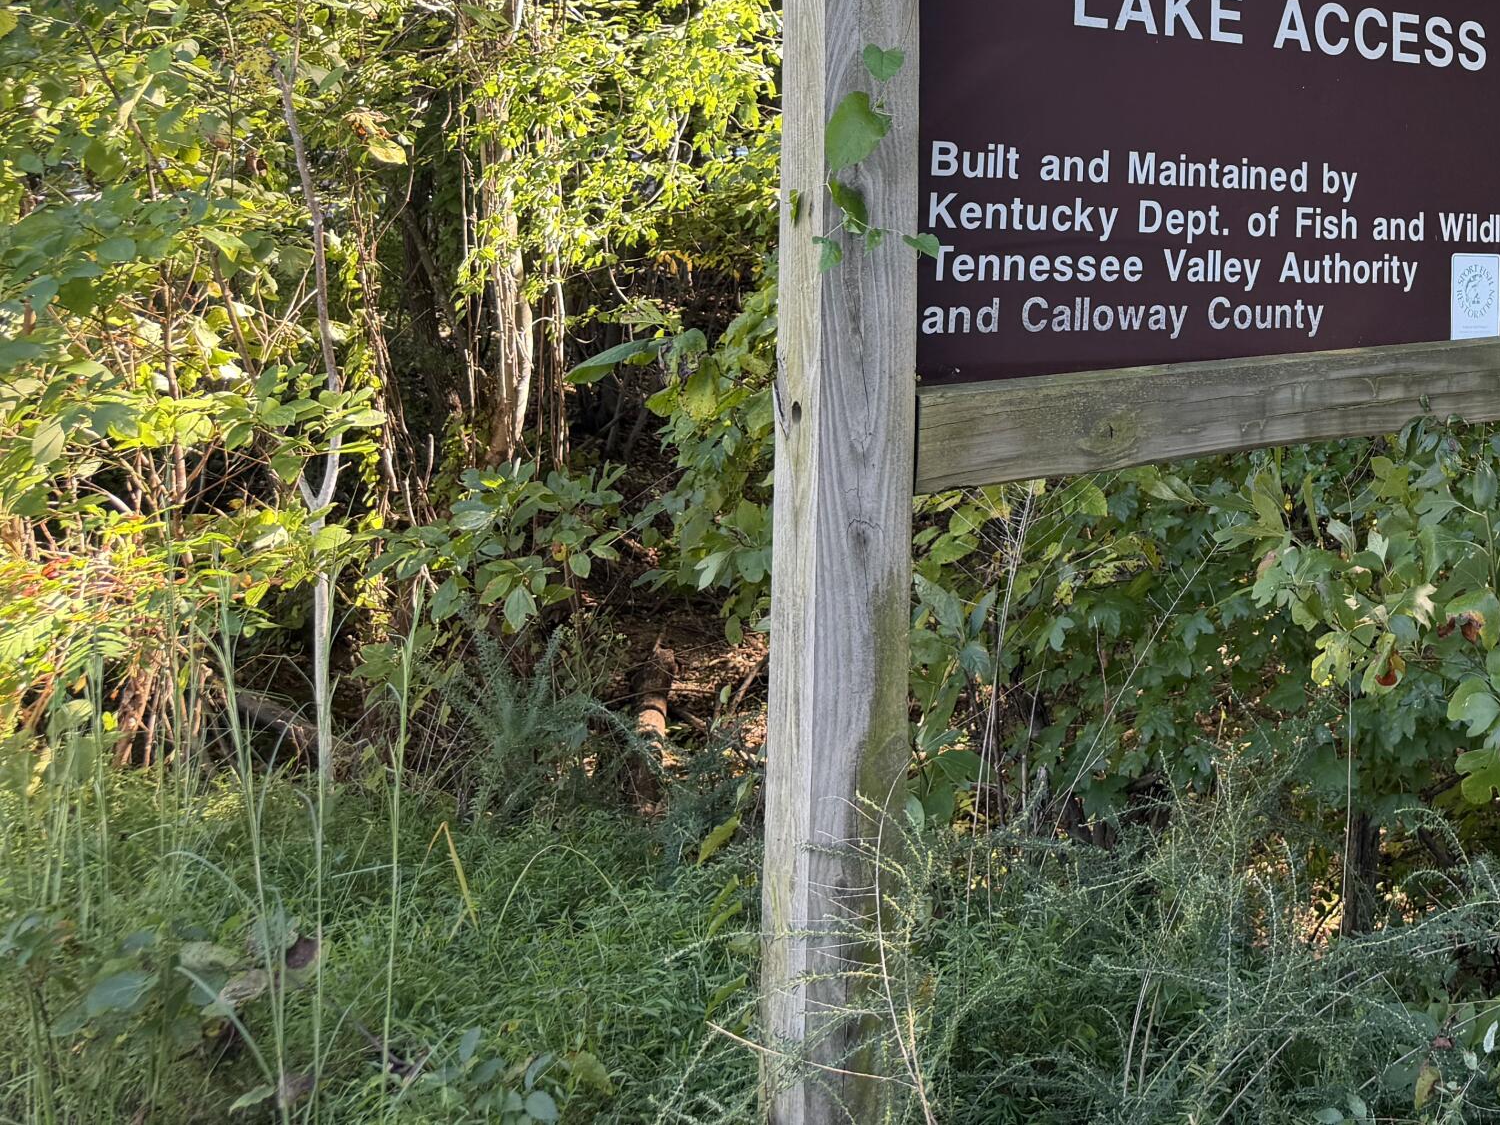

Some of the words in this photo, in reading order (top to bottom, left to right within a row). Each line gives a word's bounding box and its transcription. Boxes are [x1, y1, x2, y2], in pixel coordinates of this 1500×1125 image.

[930, 140, 1020, 180] Built
[1039, 149, 1110, 184] and
[1127, 150, 1308, 193] Maintained
[1322, 162, 1358, 203] by
[928, 192, 1119, 242] Kentucky
[1138, 199, 1229, 244] Dept.
[1247, 205, 1280, 238] of
[1295, 206, 1358, 240] Fish
[1372, 211, 1425, 242] and
[935, 245, 1143, 283] Tennessee
[1163, 248, 1262, 292] Valley
[1278, 251, 1418, 293] Authority
[1457, 264, 1479, 284] SPORT
[921, 297, 1000, 335] and
[1021, 296, 1189, 340] Calloway
[1207, 296, 1325, 338] County
